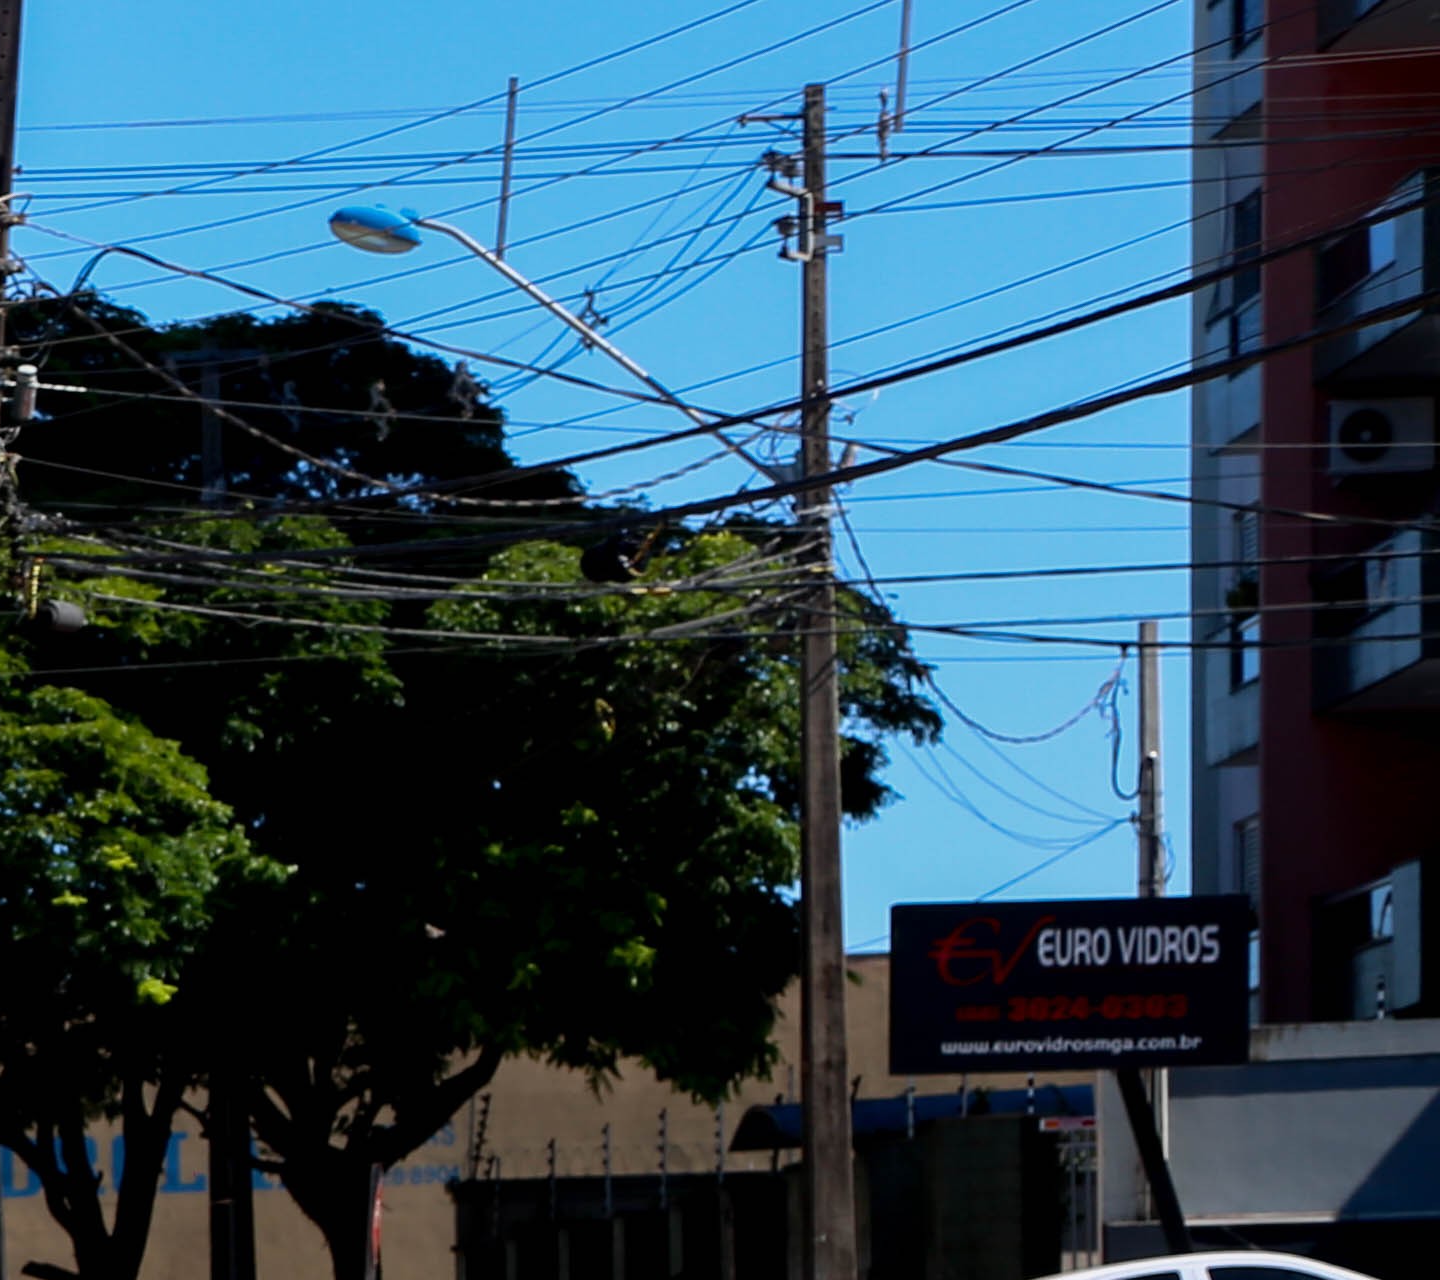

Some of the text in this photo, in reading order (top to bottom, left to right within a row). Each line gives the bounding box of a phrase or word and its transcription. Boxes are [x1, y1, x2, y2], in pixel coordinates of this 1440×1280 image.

[1037, 924, 1220, 967] EURO VIDROS
[940, 1034, 1202, 1055] www.eurovidrosmga.com.br
